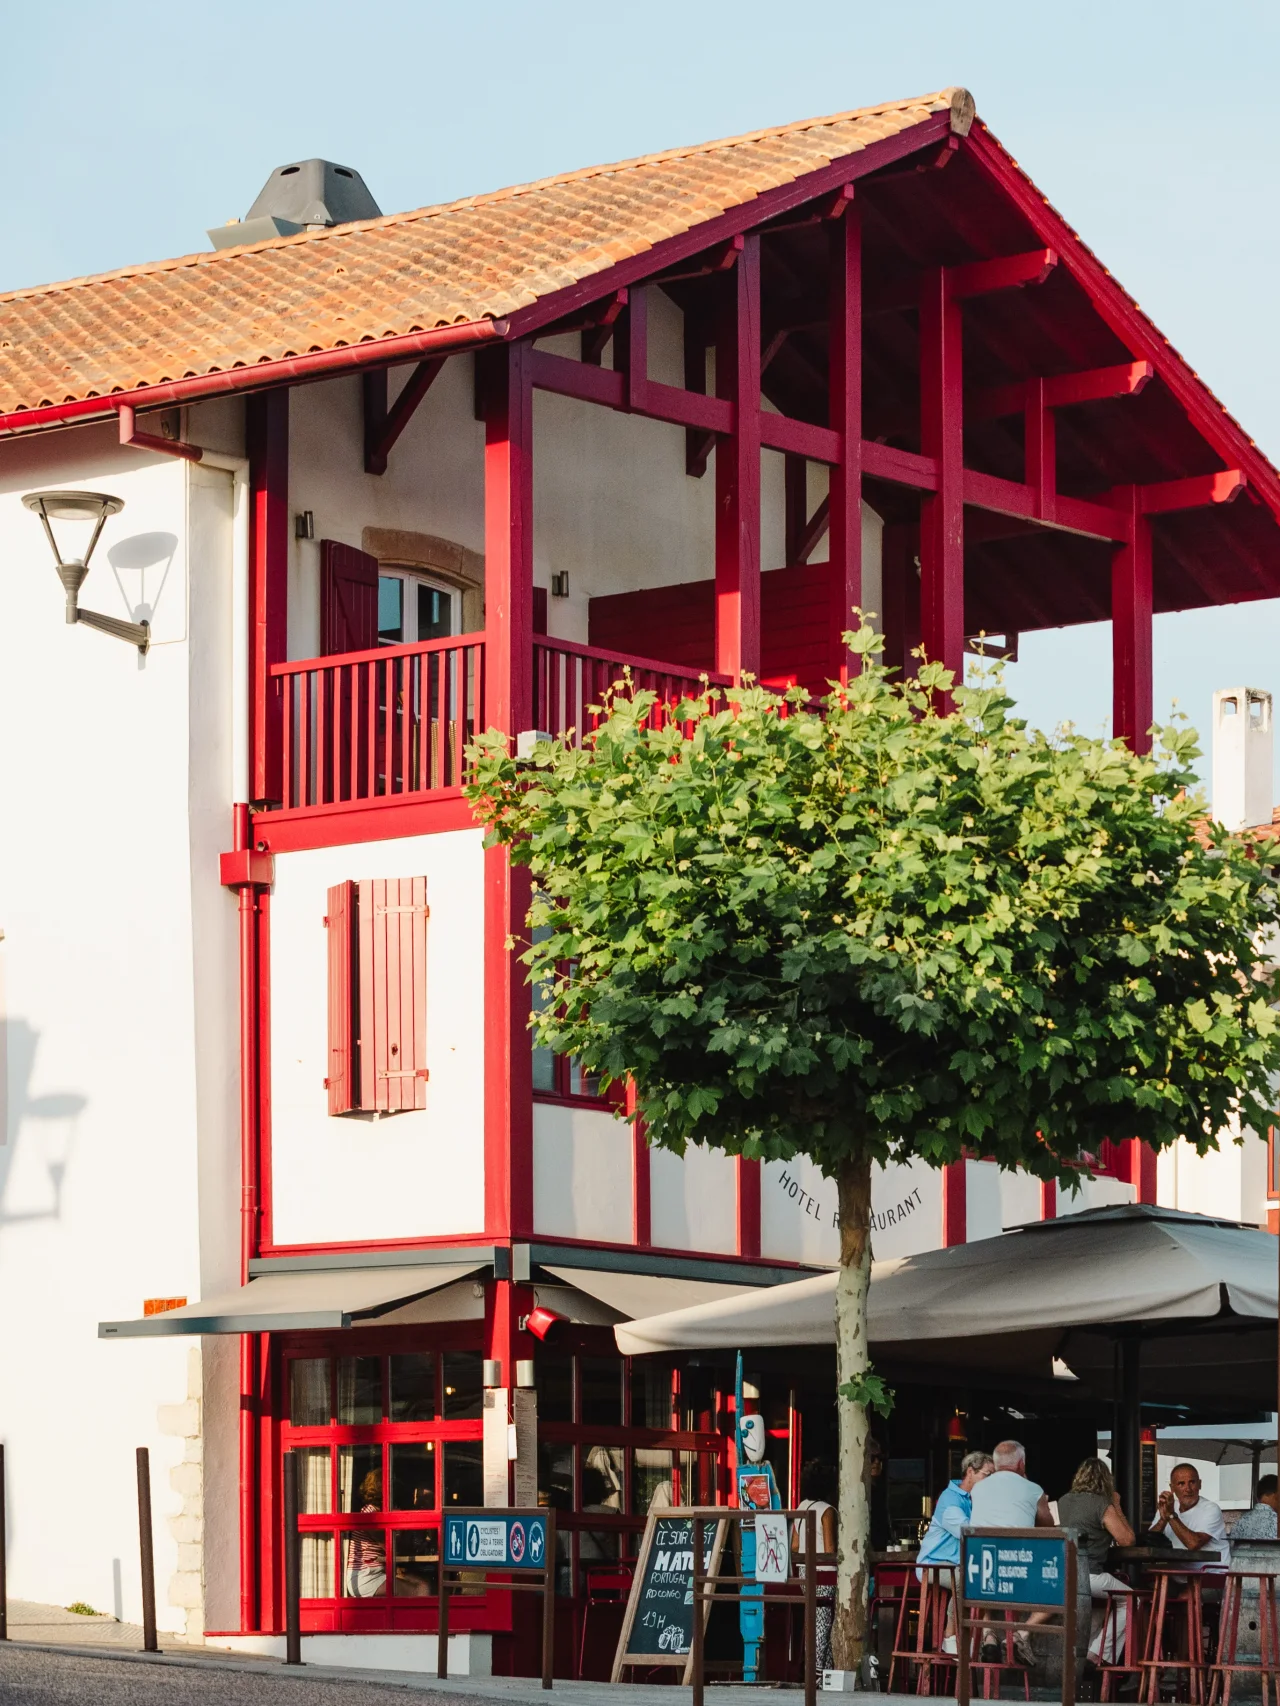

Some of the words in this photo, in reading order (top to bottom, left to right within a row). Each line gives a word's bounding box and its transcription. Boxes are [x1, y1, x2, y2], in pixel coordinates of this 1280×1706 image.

[778, 1169, 821, 1221] HOTEL
[832, 1187, 922, 1232] RAURANT
[480, 1538, 488, 1546] PIED
[492, 1538, 504, 1546] TERRE
[655, 1530, 668, 1546] CE
[668, 1530, 688, 1545] SOIR
[480, 1548, 504, 1557] OBLIGATOIRE
[650, 1571, 687, 1585] PORTUGAL
[998, 1565, 1028, 1579] OBLIGATOIRE
